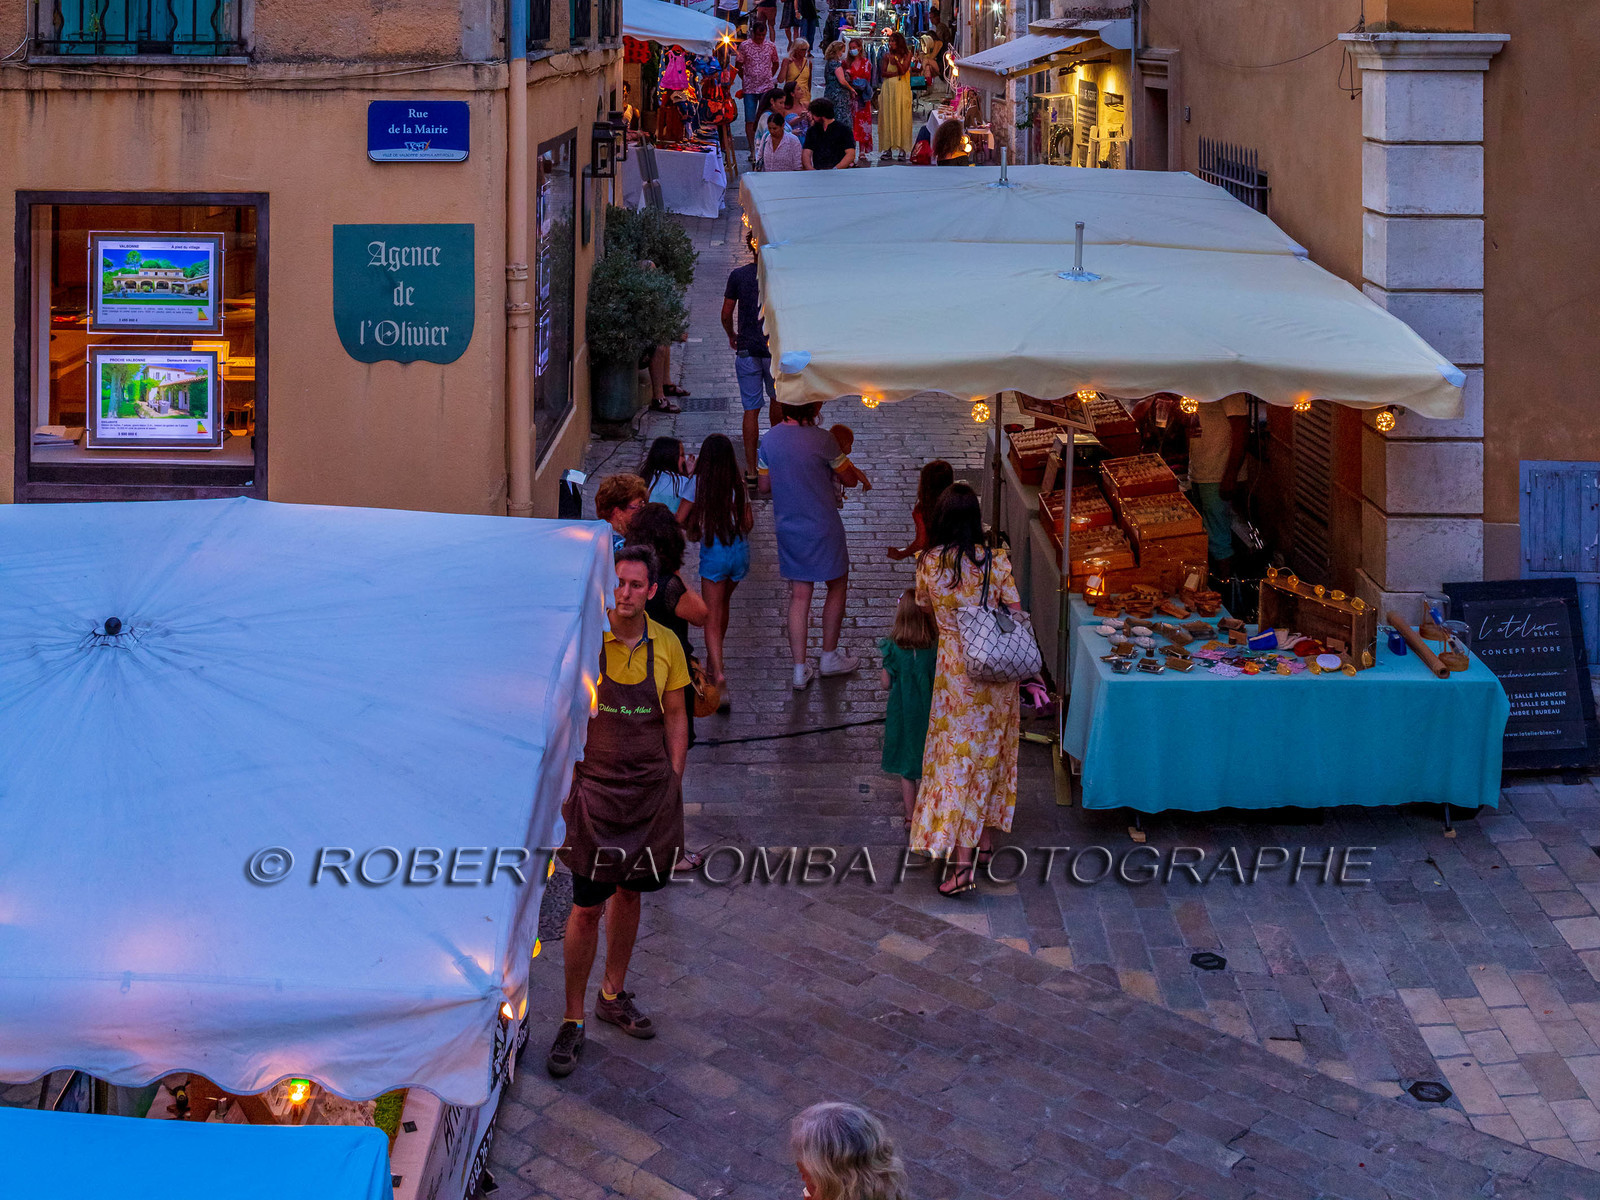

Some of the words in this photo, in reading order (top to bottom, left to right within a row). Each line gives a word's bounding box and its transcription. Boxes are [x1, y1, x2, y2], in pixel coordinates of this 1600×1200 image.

[408, 108, 429, 119] Rue
[388, 124, 401, 134] de
[403, 124, 413, 134] la
[415, 124, 449, 134] Mairie
[367, 241, 441, 272] Agence
[393, 280, 415, 307] de
[360, 320, 449, 347] l'Olivier
[1482, 647, 1526, 656] CONCEPT
[1531, 645, 1561, 653] STORE
